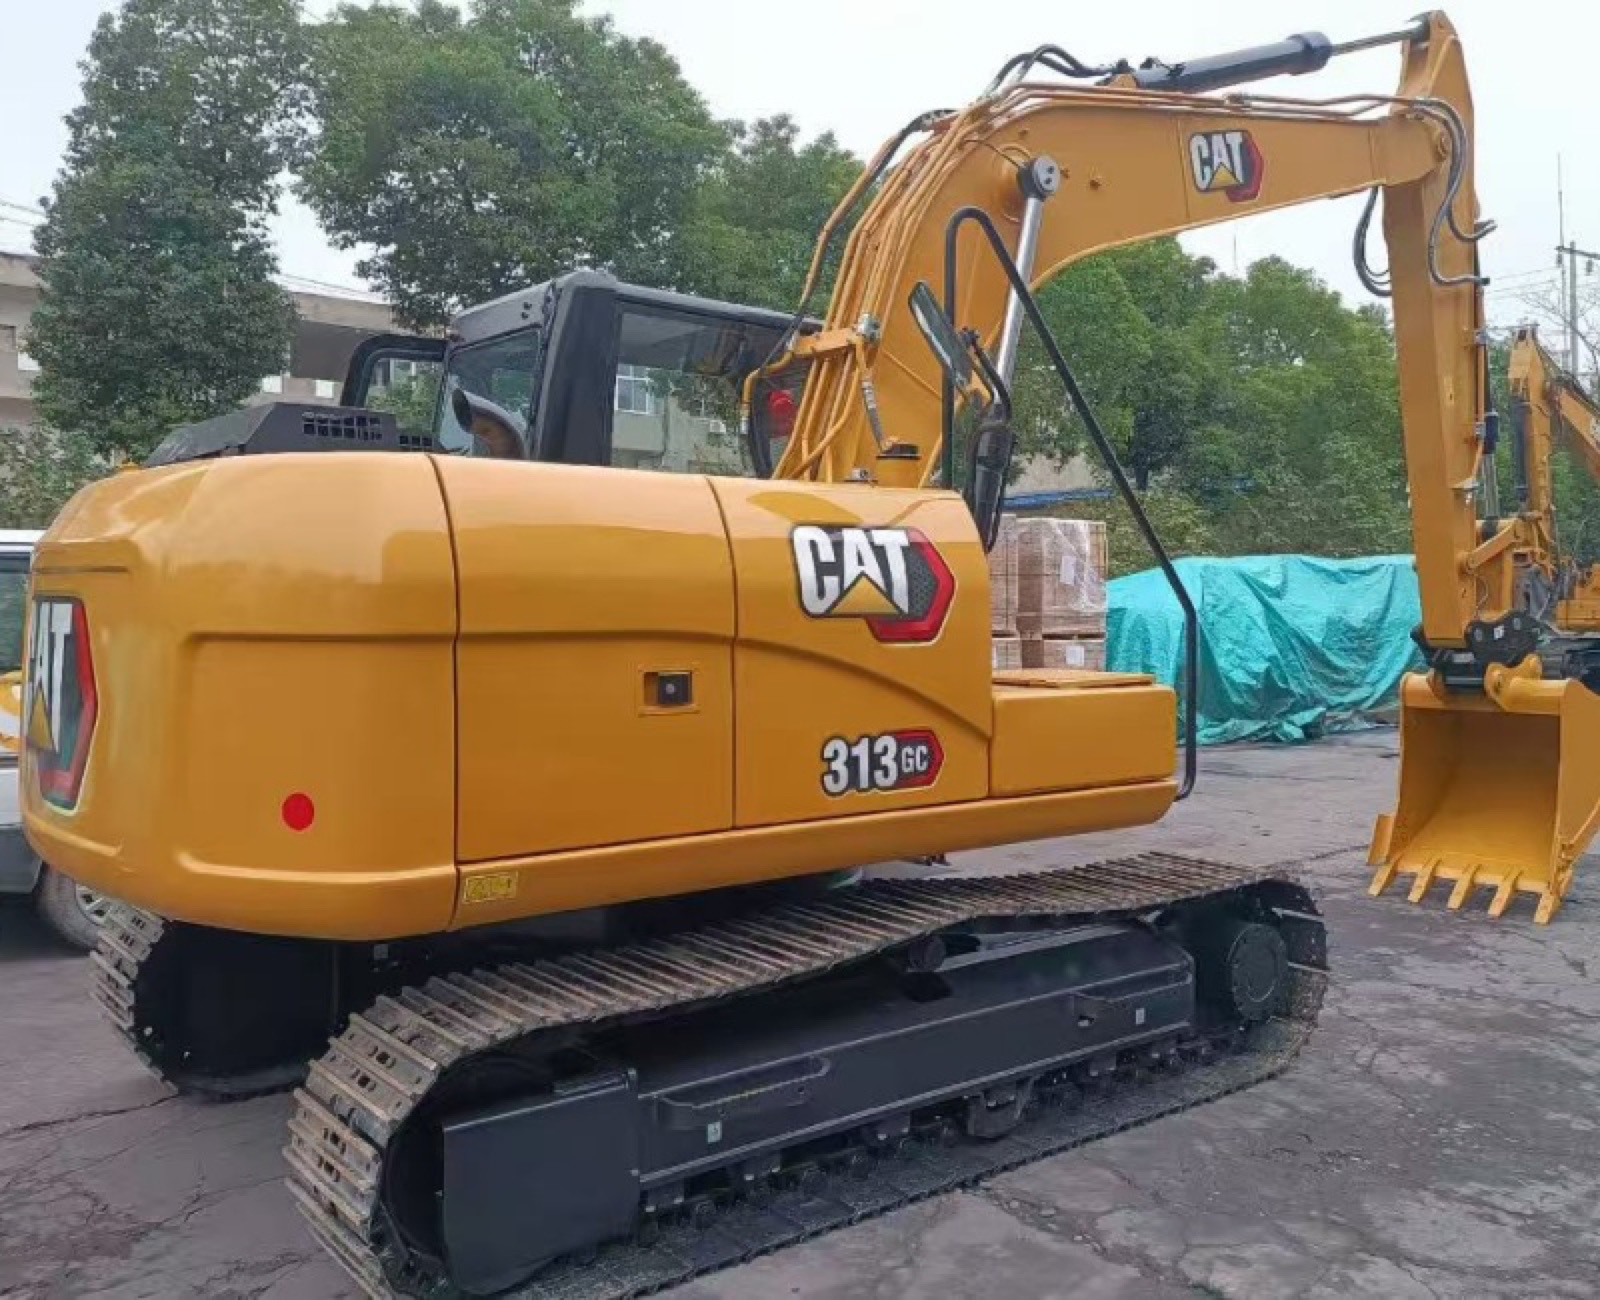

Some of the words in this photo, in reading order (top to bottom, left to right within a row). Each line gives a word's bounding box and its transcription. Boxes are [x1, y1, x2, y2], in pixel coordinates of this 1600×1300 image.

[1190, 131, 1243, 189] CAT
[793, 525, 910, 615] CAT
[823, 735, 898, 793] 313
[901, 745, 928, 773] GC
